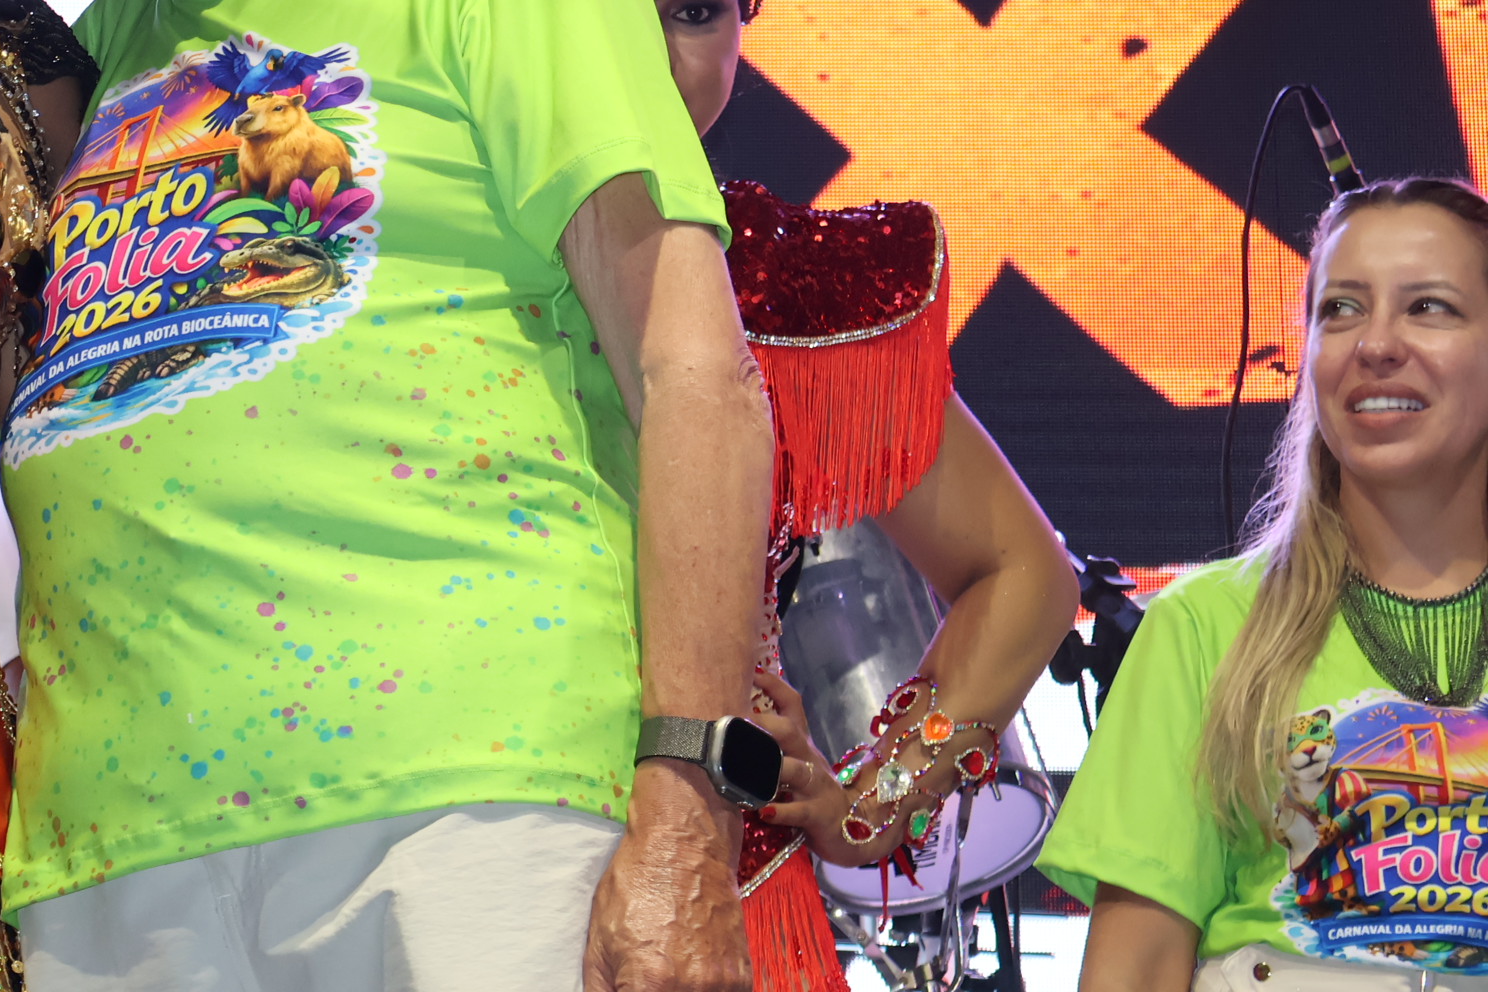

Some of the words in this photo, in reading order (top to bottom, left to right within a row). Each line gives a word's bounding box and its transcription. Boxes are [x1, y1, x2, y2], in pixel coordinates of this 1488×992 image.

[48, 167, 208, 274] Porto
[40, 225, 214, 348] Folia
[49, 278, 163, 357] 2026
[9, 371, 47, 414] ARNAVAL
[48, 361, 65, 379] DA
[66, 340, 120, 369] ALEGRIA
[122, 334, 141, 349] NA
[144, 323, 179, 344] ROTA
[181, 311, 270, 335] BIOCEÂNICA
[1350, 829, 1488, 897] Foli
[1328, 924, 1392, 940] CARNAVAL
[1395, 924, 1412, 935] DA
[1415, 924, 1464, 936] ALEGRIA
[1467, 926, 1482, 939] NA
